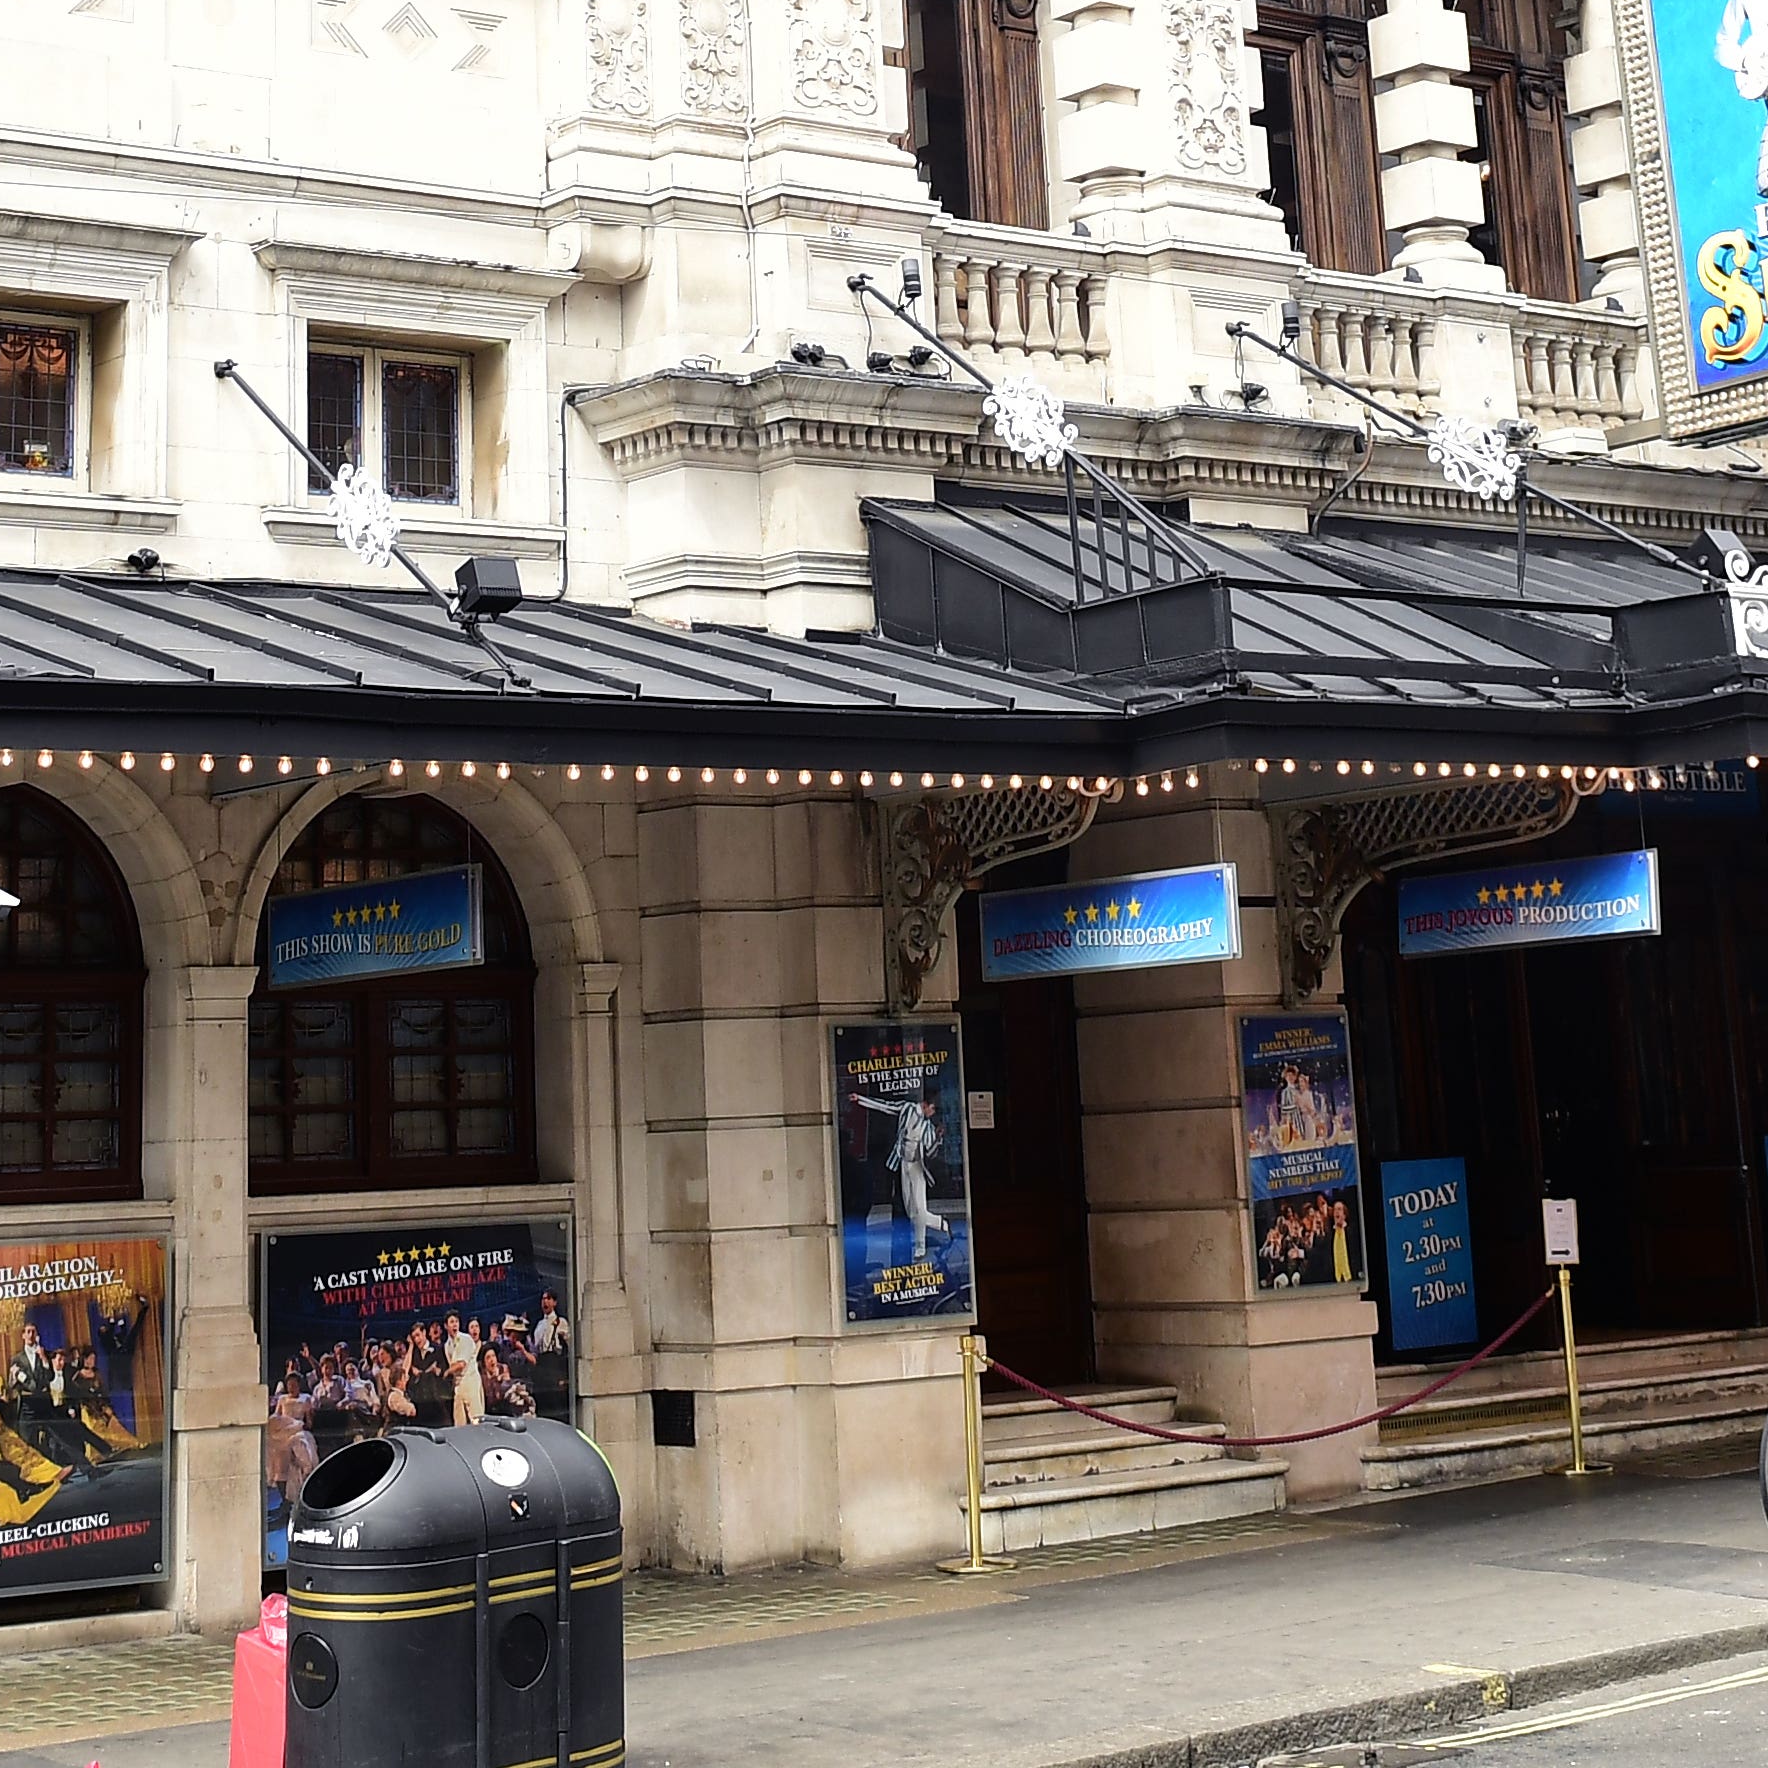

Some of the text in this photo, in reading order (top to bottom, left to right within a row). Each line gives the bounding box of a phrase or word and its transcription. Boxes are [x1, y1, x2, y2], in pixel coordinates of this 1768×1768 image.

[1404, 894, 1641, 934] THIS JOYOUS PRODUCTION
[276, 923, 463, 964] THIS SHOW IS PURE GOLD
[993, 918, 1214, 957] DAZZLING CHOREOGRAPHY
[1259, 1034, 1331, 1052] EMMA WILLIAMS
[847, 1050, 949, 1075] CHARLIE STEMP
[857, 1064, 940, 1085] IS THE STUFF OF
[879, 1078, 921, 1093] LEGEND
[1268, 1159, 1340, 1179] NUMBERS THAT
[1389, 1181, 1458, 1218] TODAY
[1422, 1217, 1435, 1229] at
[1402, 1234, 1462, 1263] 2.30PM
[327, 1270, 370, 1289] CAST
[370, 1263, 413, 1282] WHO
[414, 1260, 448, 1277] ARE
[450, 1256, 475, 1272] ON
[477, 1248, 515, 1268] FIRE
[882, 1261, 934, 1280] WINNER!
[1424, 1258, 1447, 1276] and
[322, 1265, 507, 1305] WITH CHARLIE ABLAZE
[873, 1273, 945, 1295] BEST ACTOR
[881, 1293, 892, 1304] IN
[892, 1292, 899, 1302] A
[900, 1285, 940, 1300] MUSICAL
[1412, 1279, 1467, 1308] 7.30PM
[359, 1300, 379, 1318] AT
[383, 1294, 415, 1313] THE
[1, 1537, 69, 1559] MUSICAL
